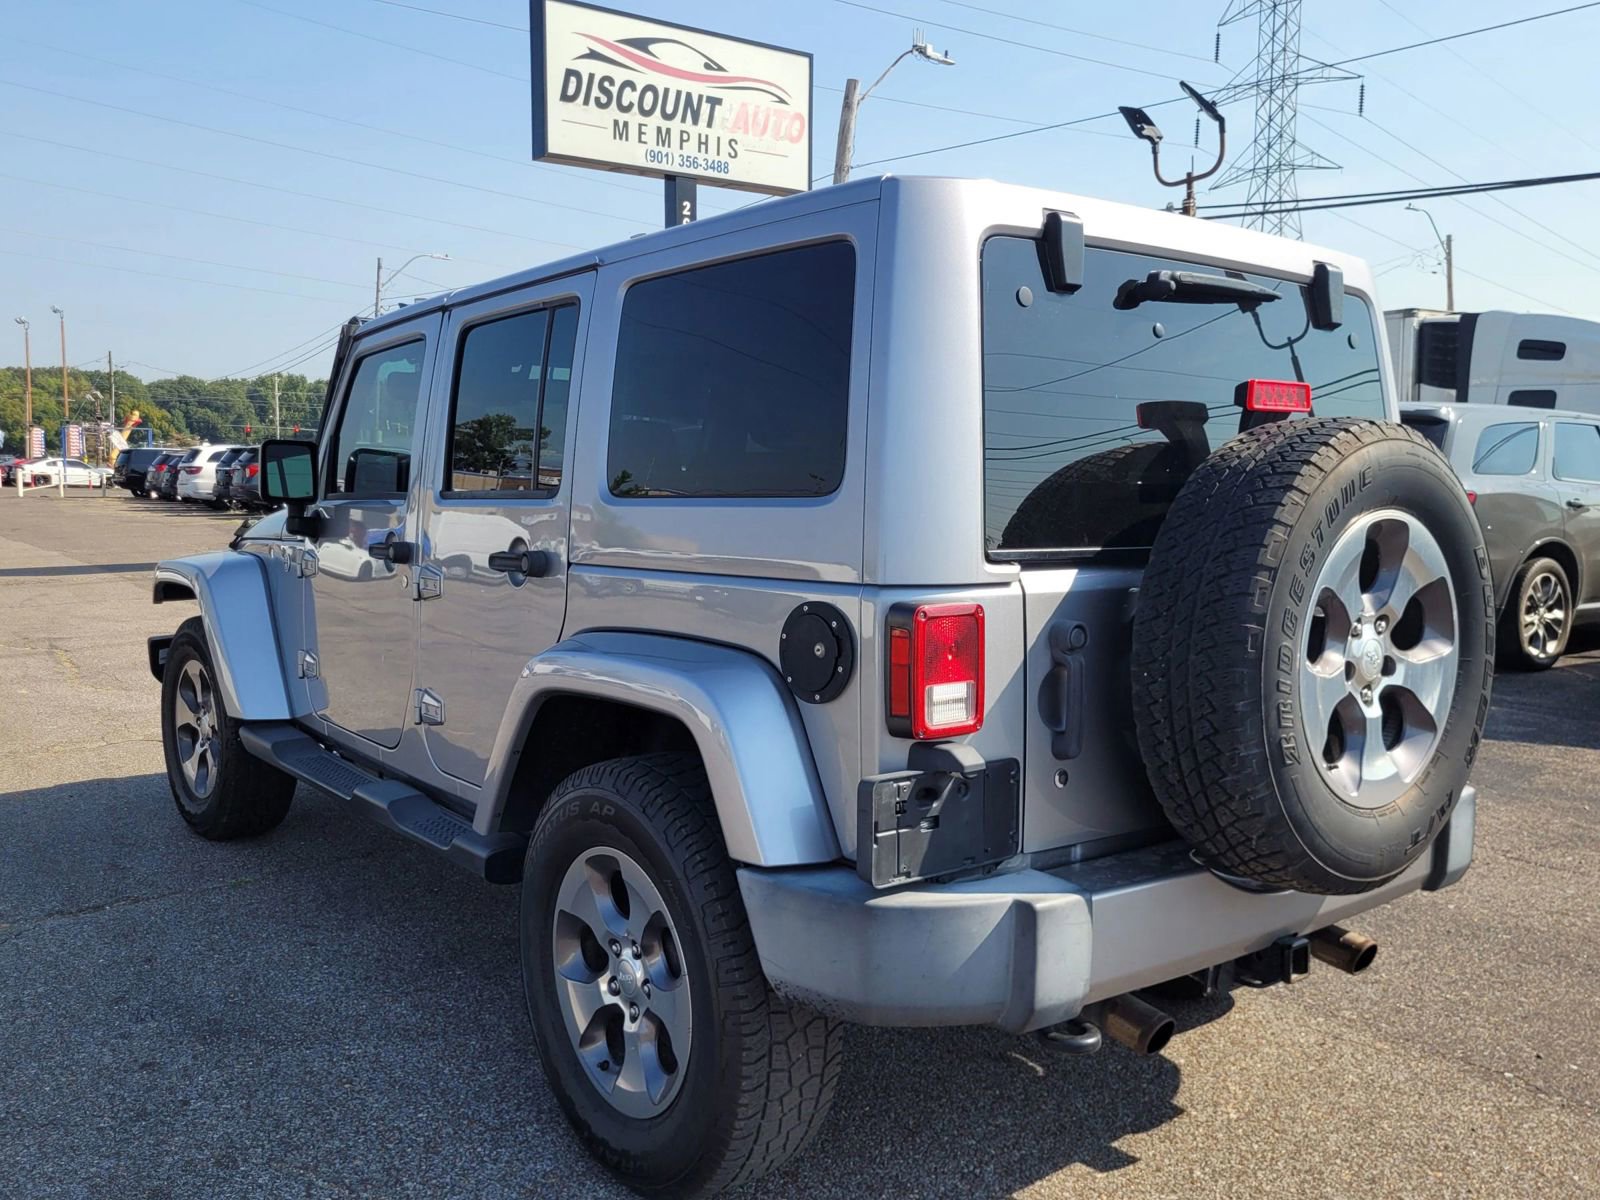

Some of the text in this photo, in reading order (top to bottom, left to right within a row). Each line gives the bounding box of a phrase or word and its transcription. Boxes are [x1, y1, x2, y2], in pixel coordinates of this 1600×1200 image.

[559, 68, 806, 145] DISCOUNT AUTO
[613, 118, 739, 160] MEMPHIS
[645, 149, 730, 175] (901) 356-3488
[1275, 464, 1374, 767] BRIDGESTONE
